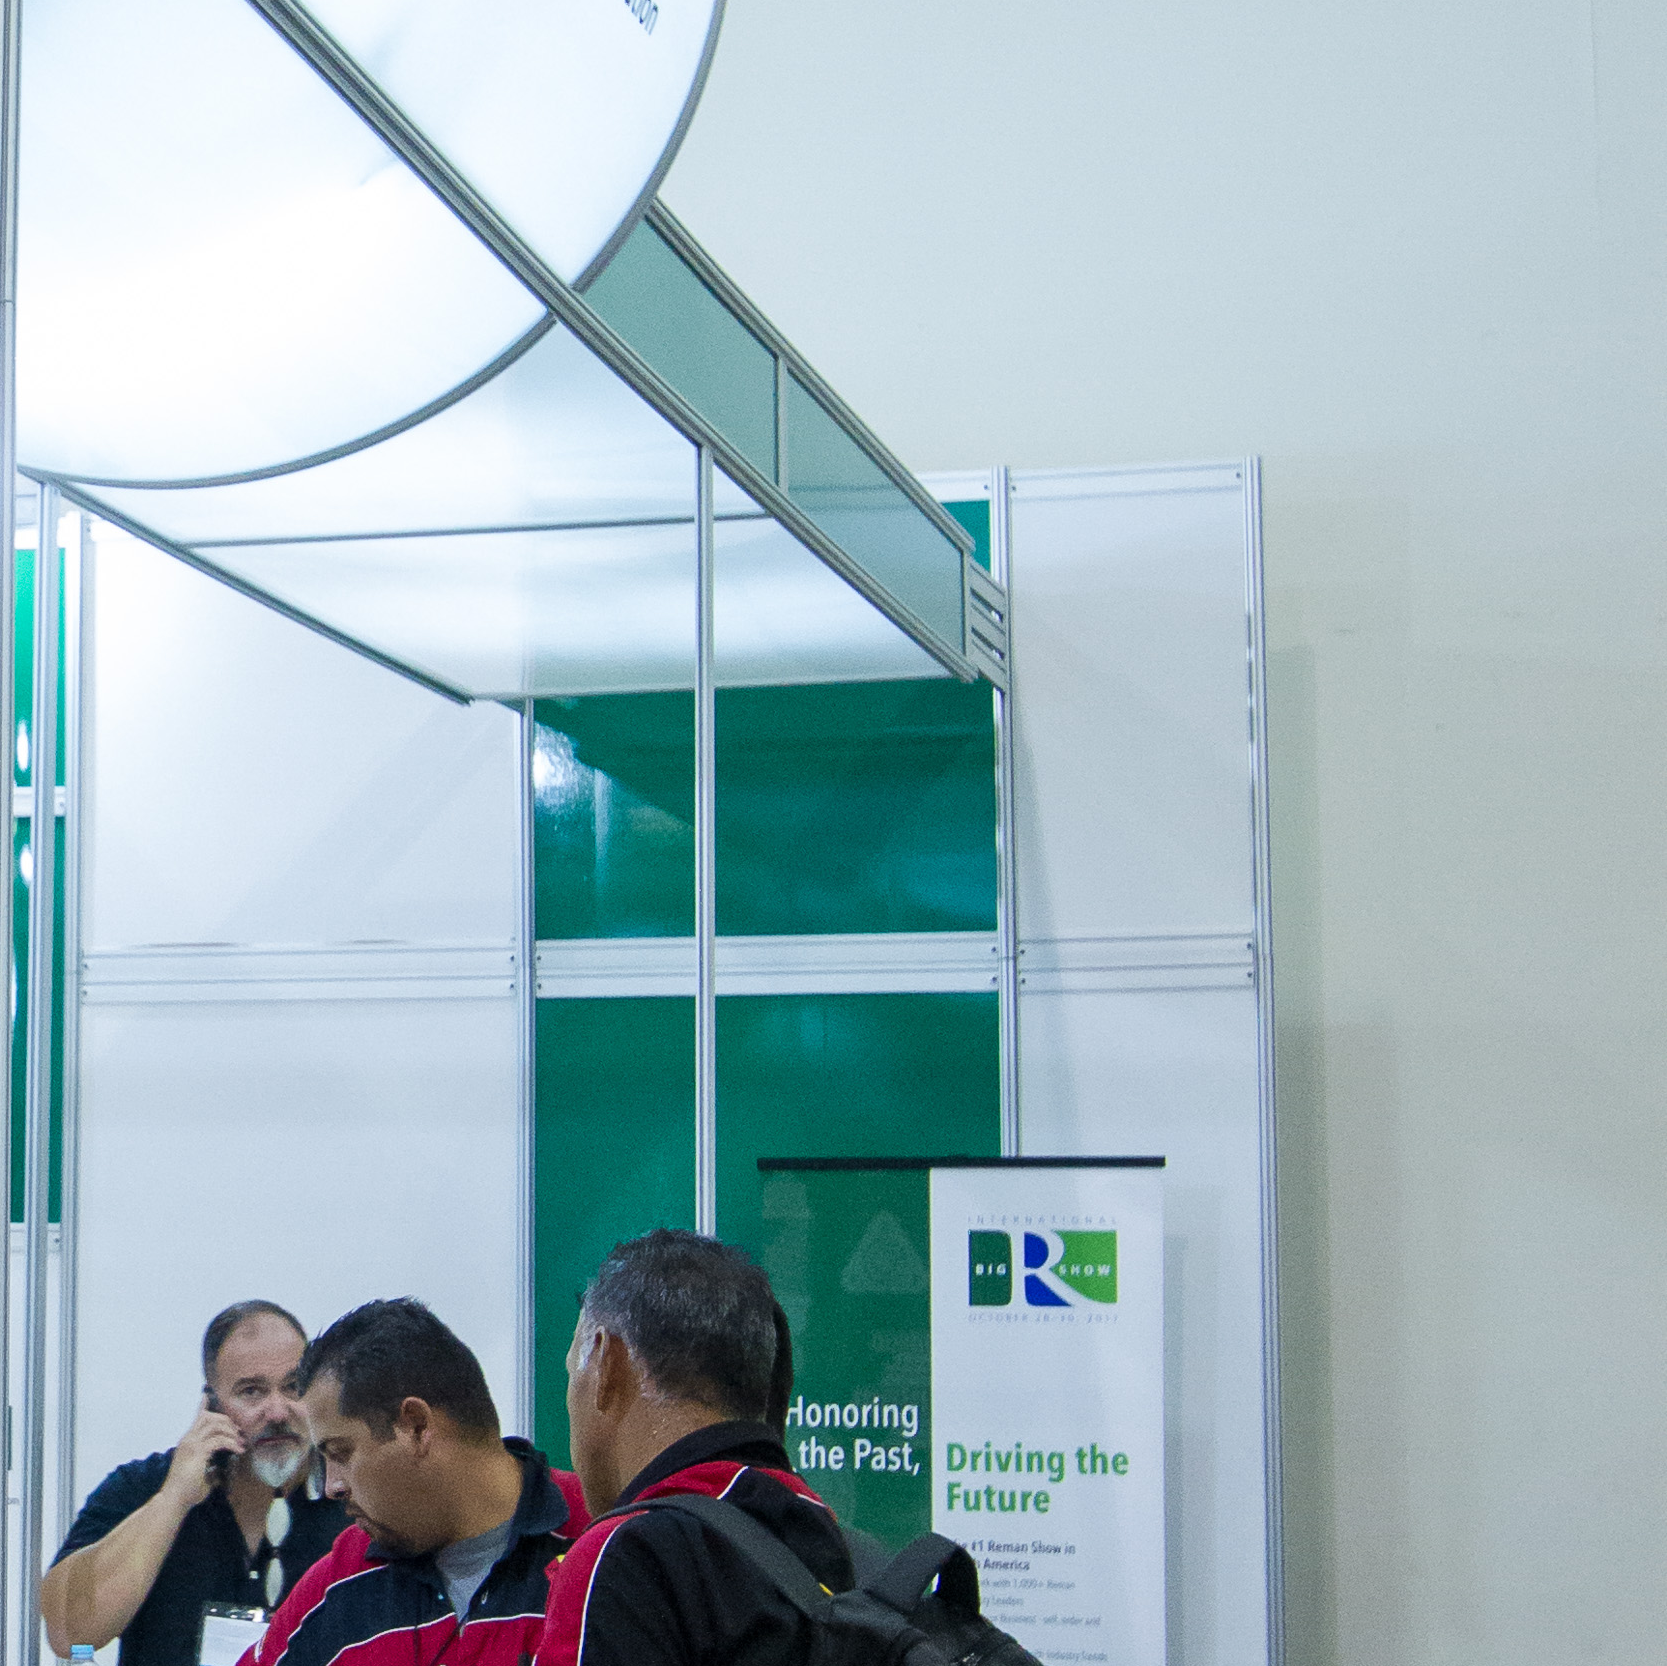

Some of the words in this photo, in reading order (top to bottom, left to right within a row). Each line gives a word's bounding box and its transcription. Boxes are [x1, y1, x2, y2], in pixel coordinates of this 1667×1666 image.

[975, 1263, 1007, 1276] BIG
[786, 1396, 919, 1437] Honoring
[798, 1436, 845, 1471] the
[854, 1439, 921, 1477] Past,
[946, 1441, 1065, 1483] Driving
[1075, 1443, 1130, 1476] the
[946, 1482, 1051, 1514] Future
